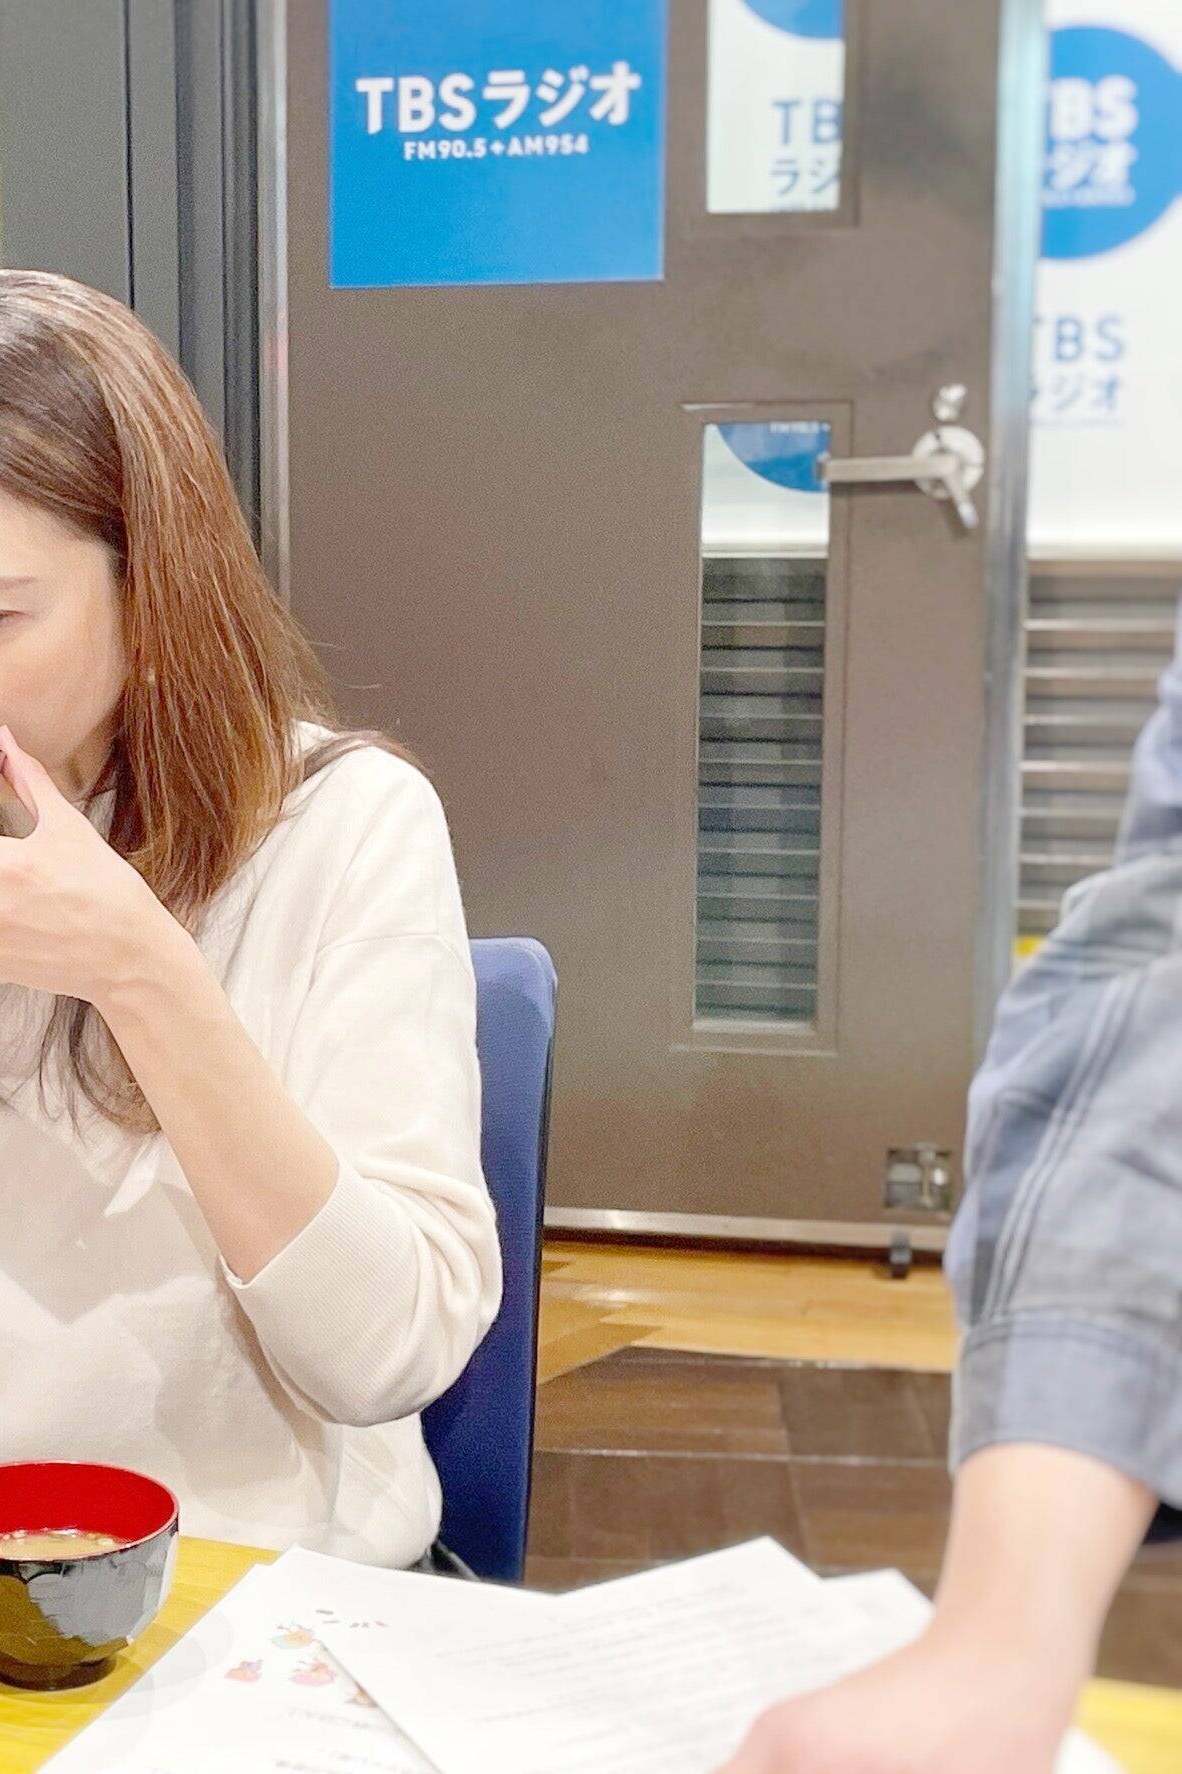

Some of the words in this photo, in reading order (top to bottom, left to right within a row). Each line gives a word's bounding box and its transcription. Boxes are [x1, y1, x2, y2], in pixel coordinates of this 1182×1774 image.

[355, 60, 642, 135] TBSラジオ
[1047, 75, 1139, 138] BS
[1032, 313, 1125, 362] BS
